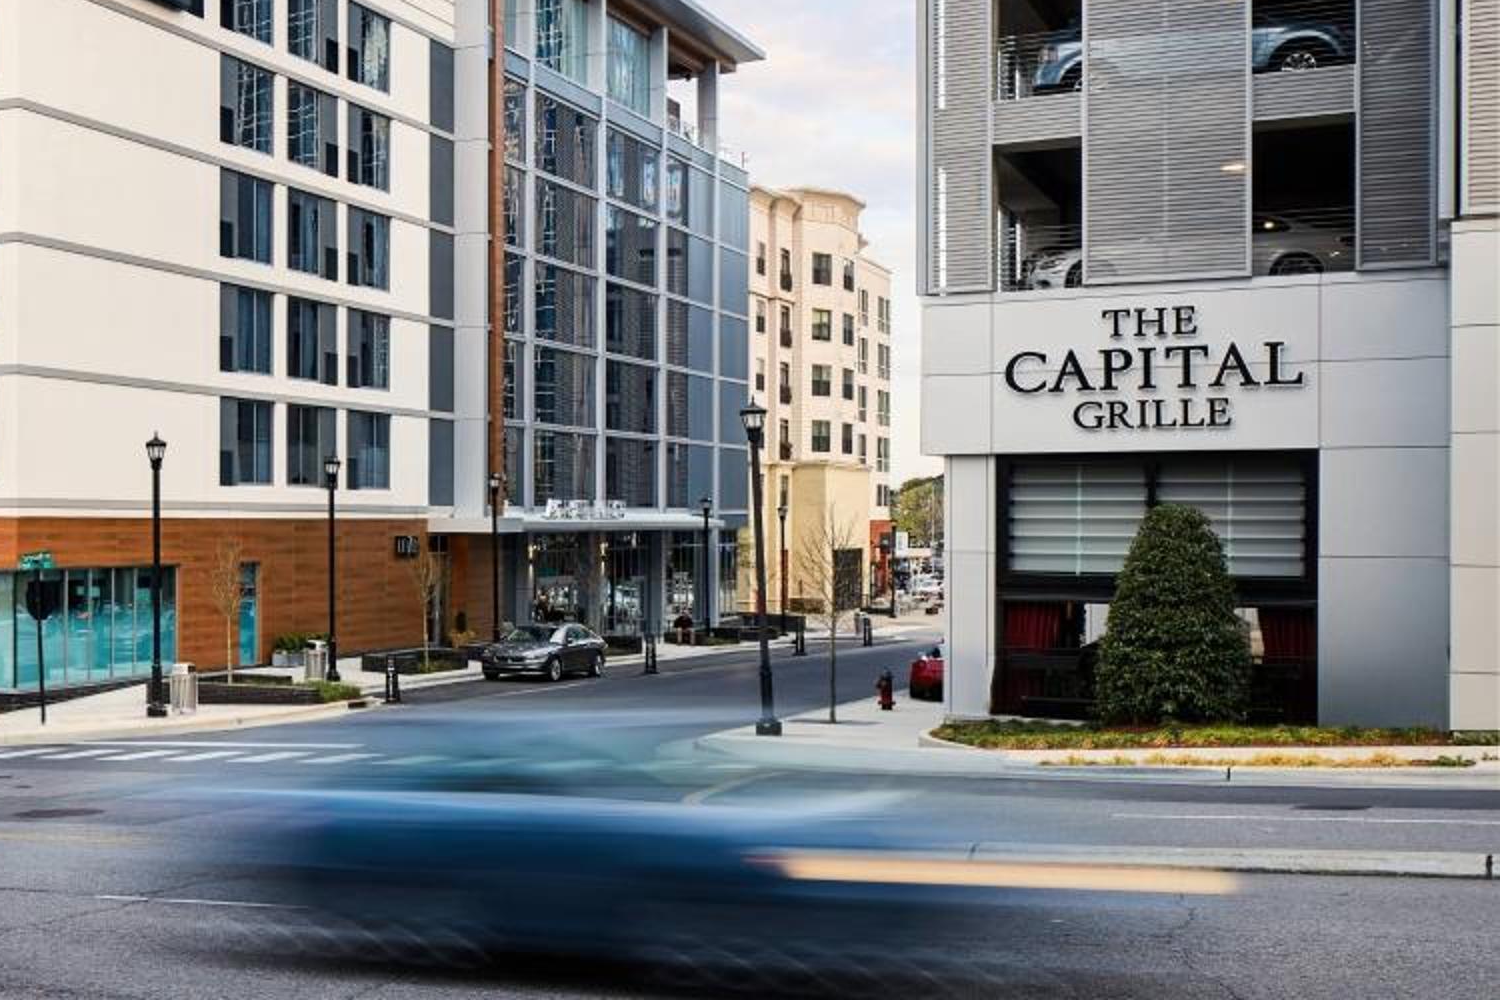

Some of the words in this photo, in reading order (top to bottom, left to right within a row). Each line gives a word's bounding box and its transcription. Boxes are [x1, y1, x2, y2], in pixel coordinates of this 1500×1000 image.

[1102, 306, 1198, 338] THE
[1005, 341, 1303, 393] CAPITAL
[1073, 398, 1232, 430] GRILLE
